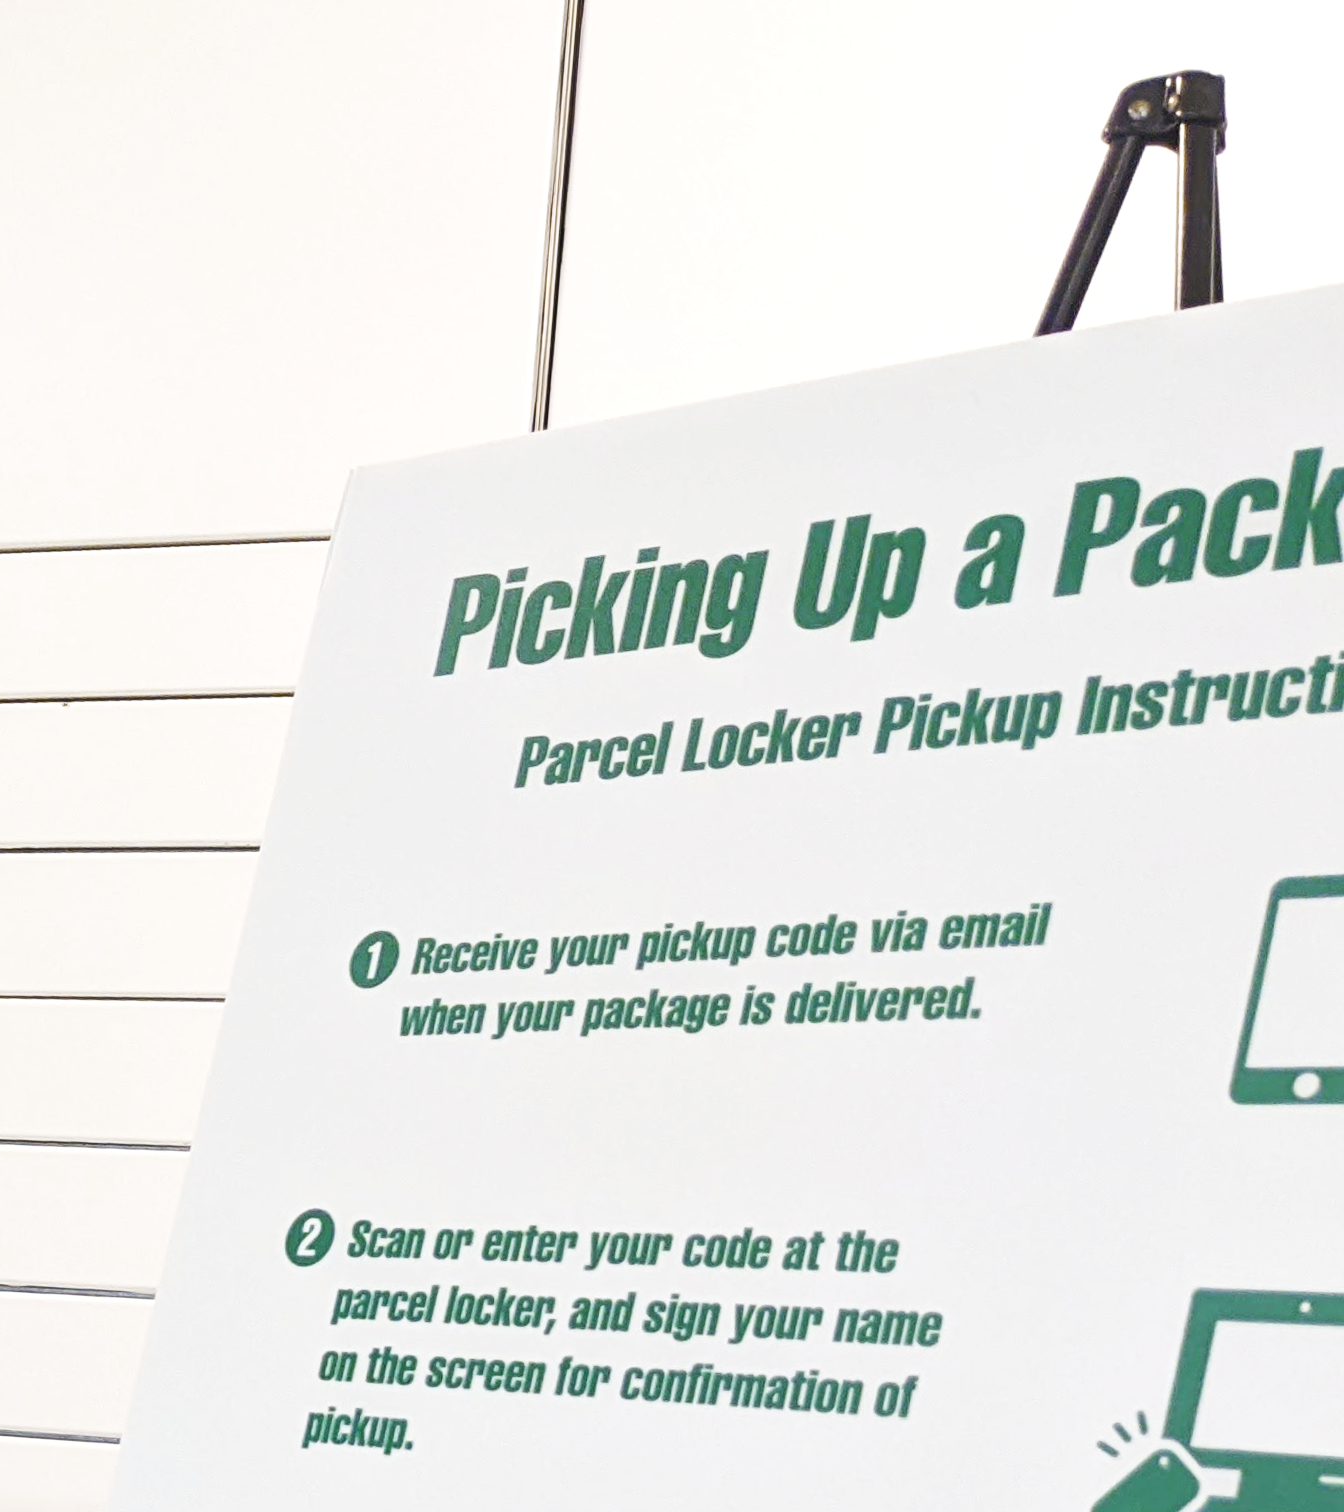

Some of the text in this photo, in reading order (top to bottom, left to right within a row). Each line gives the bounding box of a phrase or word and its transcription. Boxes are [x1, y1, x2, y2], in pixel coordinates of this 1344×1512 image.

[434, 447, 1344, 676] Picking Up a Pack
[515, 722, 673, 788] Parcel
[682, 709, 862, 772] Locker
[874, 688, 1062, 753] Pickup
[366, 903, 1052, 980] 1 Receive your pickup code via email
[400, 977, 980, 1039] when your package is delivered.
[296, 1217, 899, 1273] 2 Scan or enter your code at the
[331, 1285, 942, 1347] parcel locker, and sign your name
[319, 1347, 918, 1417] on the screen for confirmation of
[302, 1408, 413, 1455] pickup.
